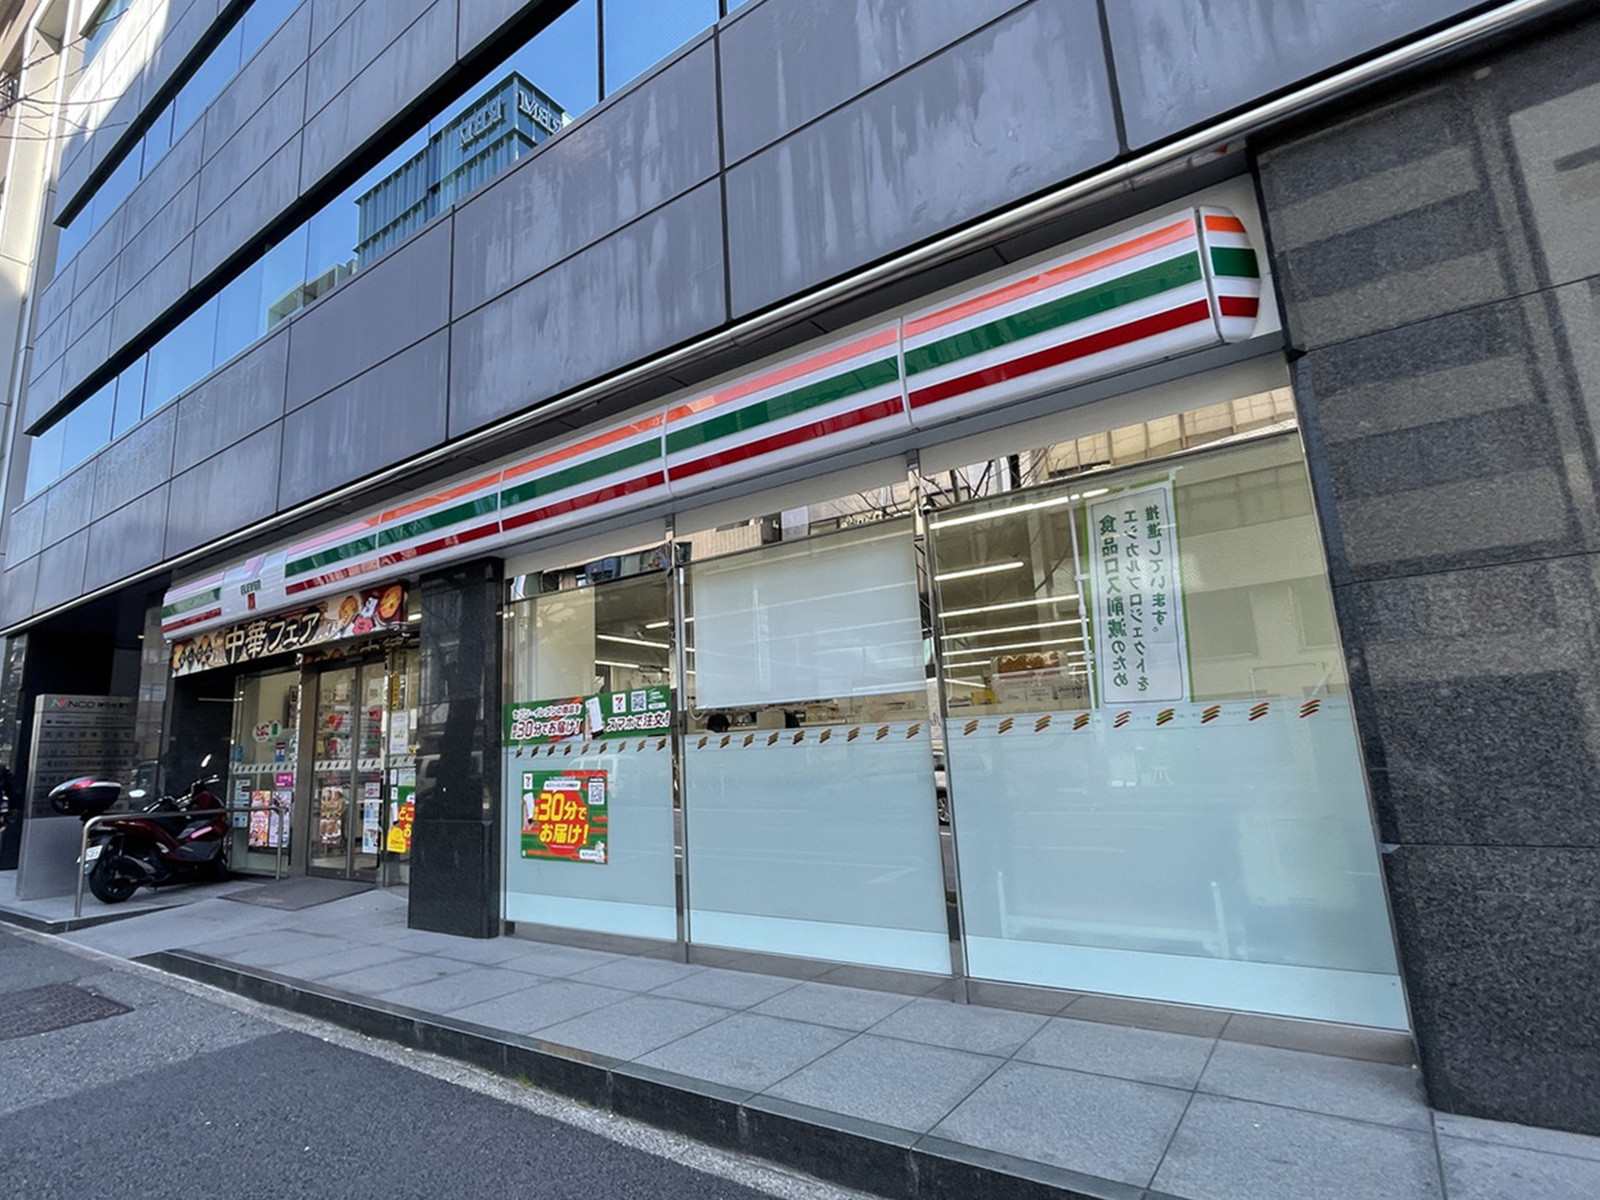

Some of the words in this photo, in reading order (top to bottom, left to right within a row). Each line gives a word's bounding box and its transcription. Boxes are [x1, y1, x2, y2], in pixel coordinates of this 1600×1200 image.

[225, 611, 320, 664] 中華フェア
[539, 823, 589, 844] お届け!
